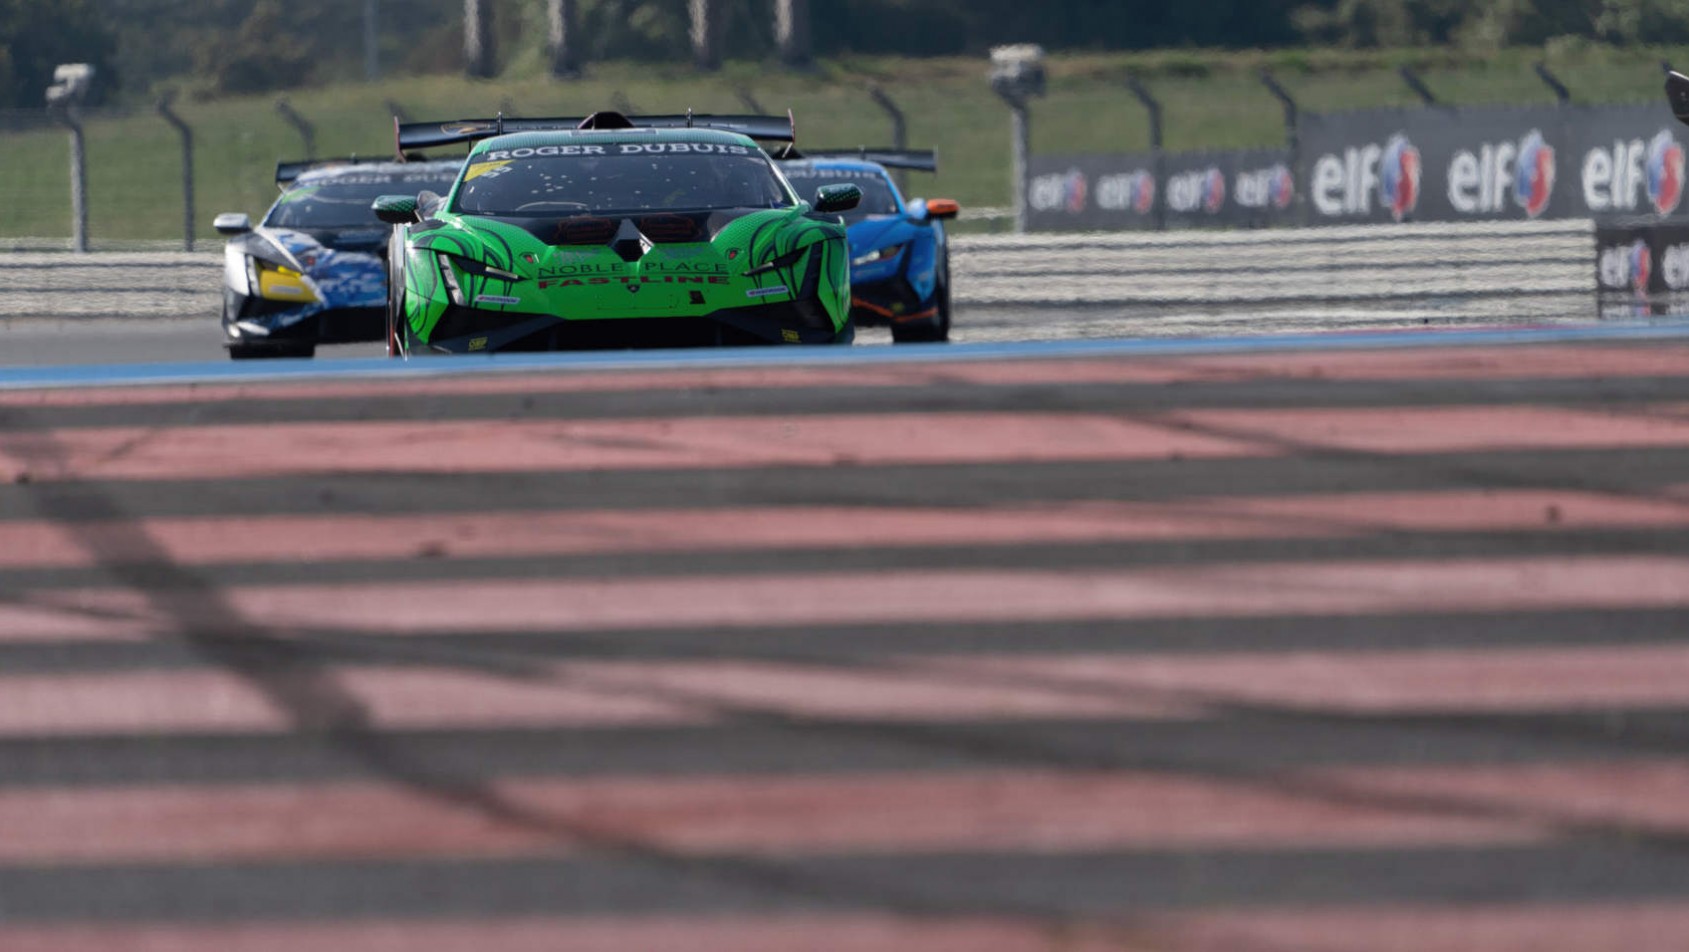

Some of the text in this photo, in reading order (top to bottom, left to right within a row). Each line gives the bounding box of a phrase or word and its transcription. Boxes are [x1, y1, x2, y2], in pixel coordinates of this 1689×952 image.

[487, 143, 749, 161] ROGER DUBUIS
[1312, 138, 1645, 215] elf elf elf
[538, 262, 729, 275] NOBLE PLACE
[1663, 242, 1689, 290] el
[537, 276, 731, 289] FASTLINE
